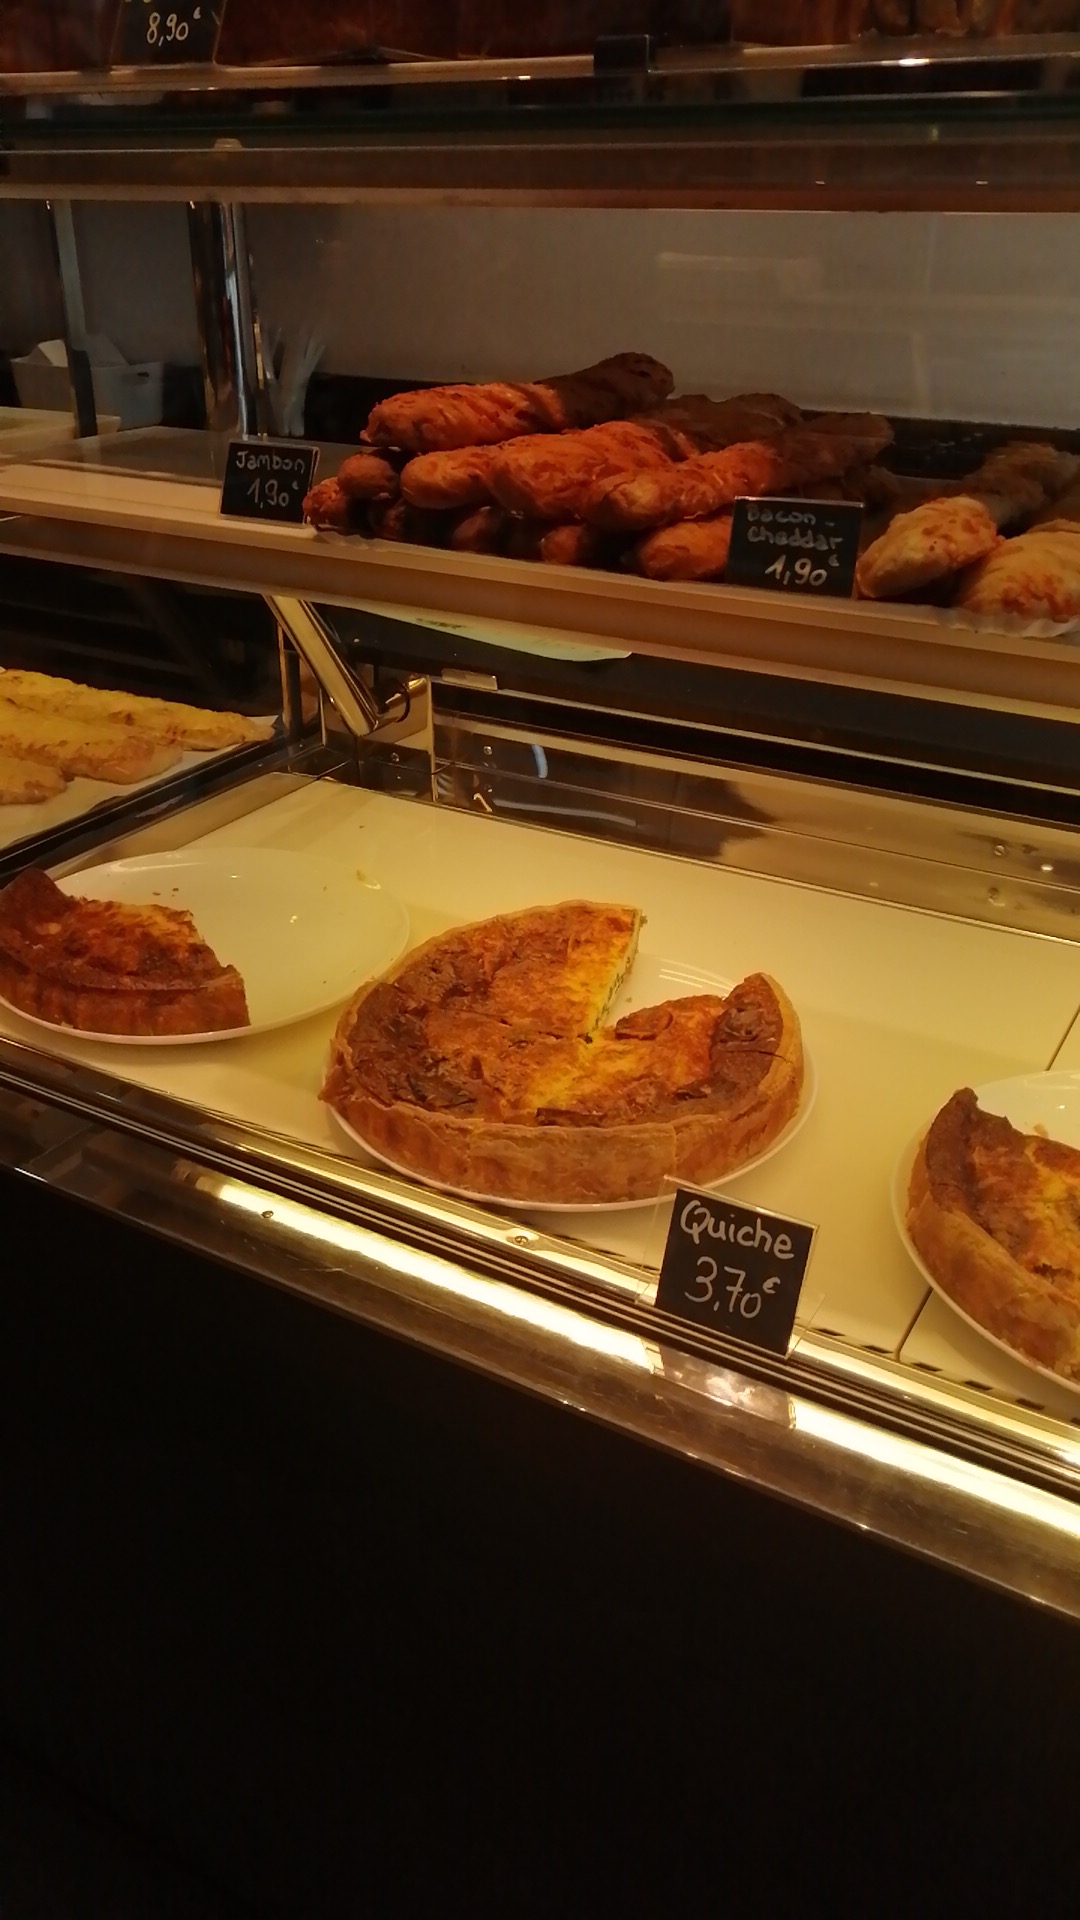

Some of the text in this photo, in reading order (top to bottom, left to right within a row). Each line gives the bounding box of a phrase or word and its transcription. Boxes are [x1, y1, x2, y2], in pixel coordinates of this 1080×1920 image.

[236, 450, 305, 474] Jambon
[680, 1199, 795, 1260] Quiche
[684, 1256, 781, 1319] 3,70€
